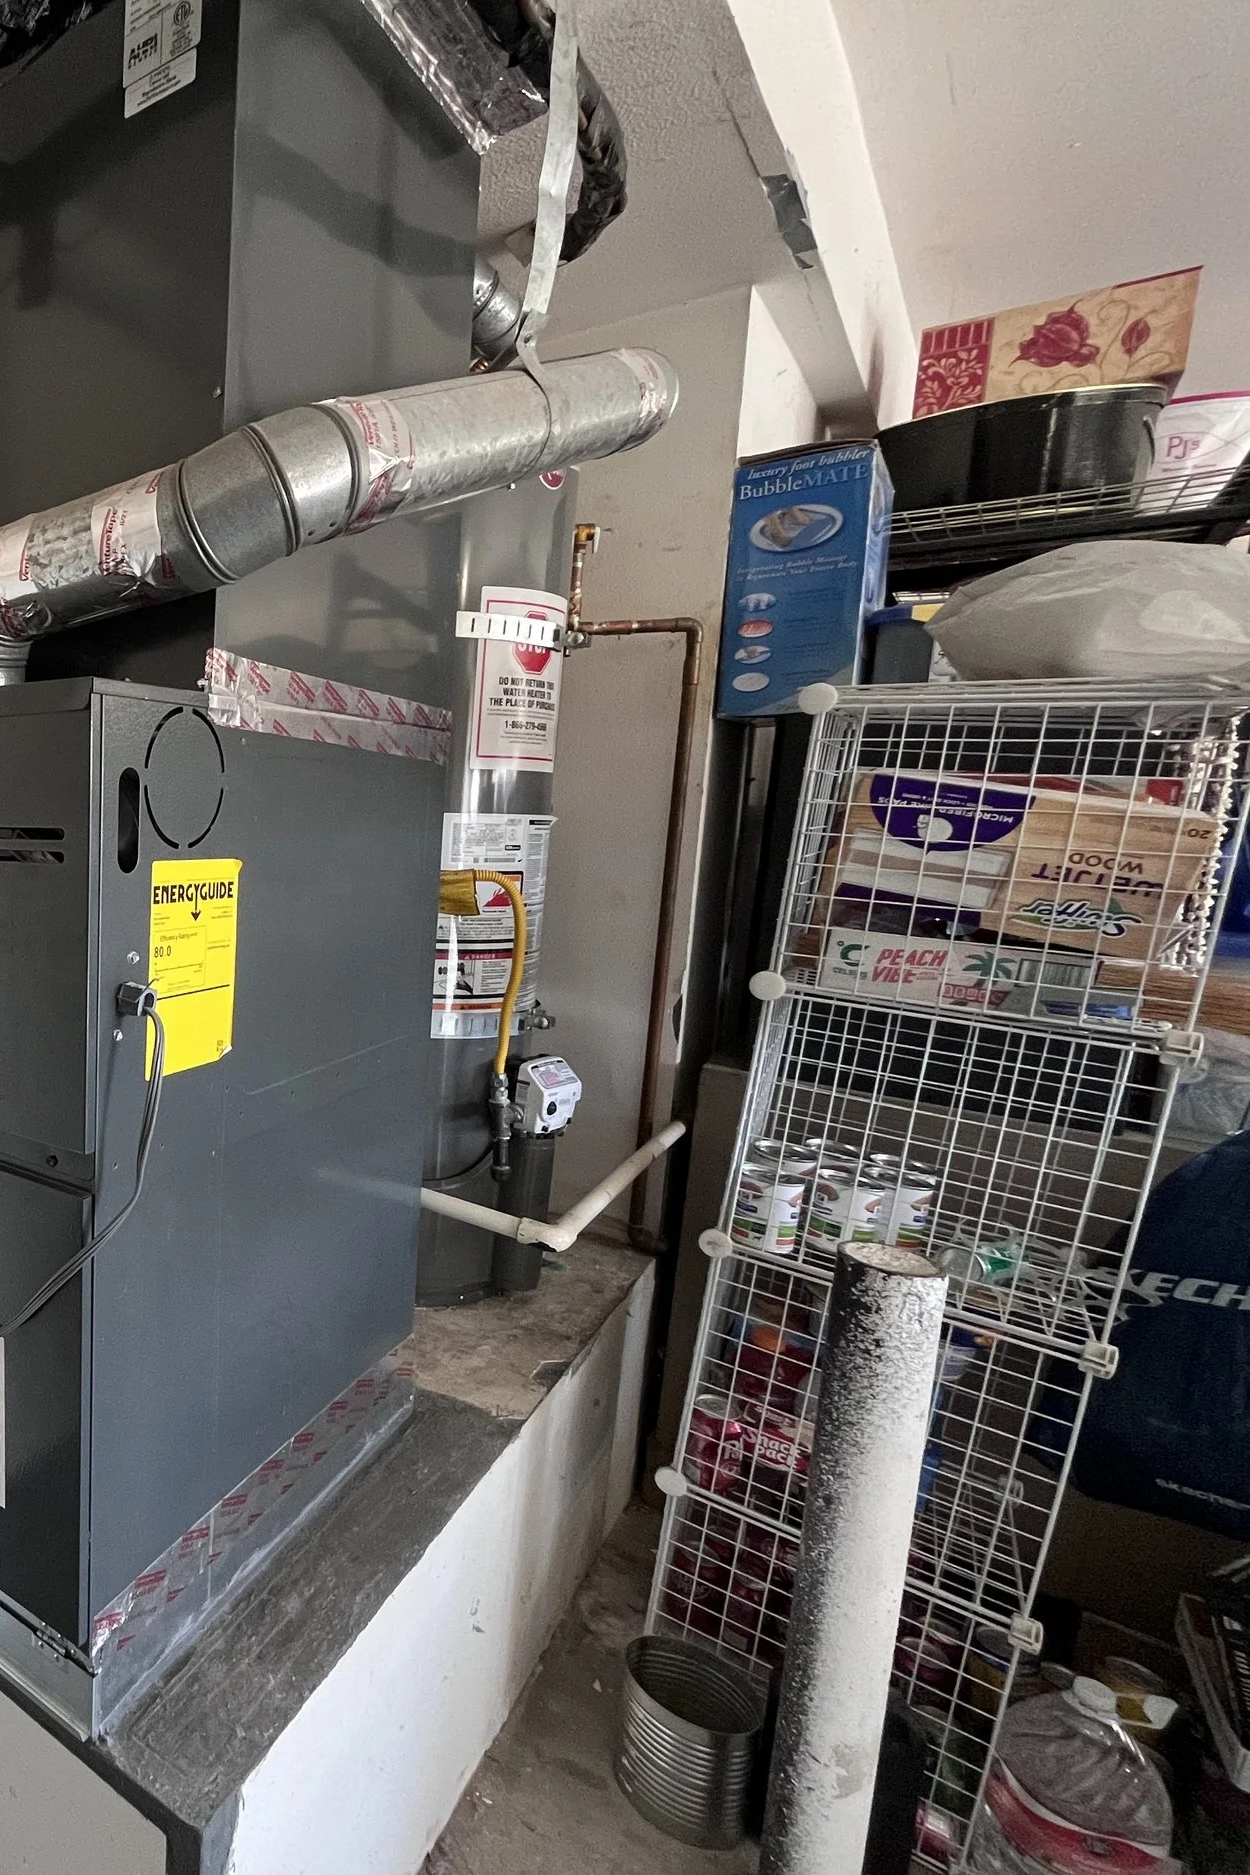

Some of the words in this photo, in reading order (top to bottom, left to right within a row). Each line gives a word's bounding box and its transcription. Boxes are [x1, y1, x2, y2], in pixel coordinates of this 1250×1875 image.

[818, 450, 870, 466] bubbler
[739, 463, 869, 500] BubbleMATE
[499, 676, 509, 685] DO
[503, 687, 526, 697] WATER
[489, 697, 504, 707] THE
[505, 698, 527, 708] PLACE
[1187, 828, 1212, 840] 20
[1068, 852, 1144, 875] WOOD
[153, 881, 234, 905] ENERGYGUIDE
[876, 948, 949, 966] PEACH
[872, 965, 918, 984] VIBE
